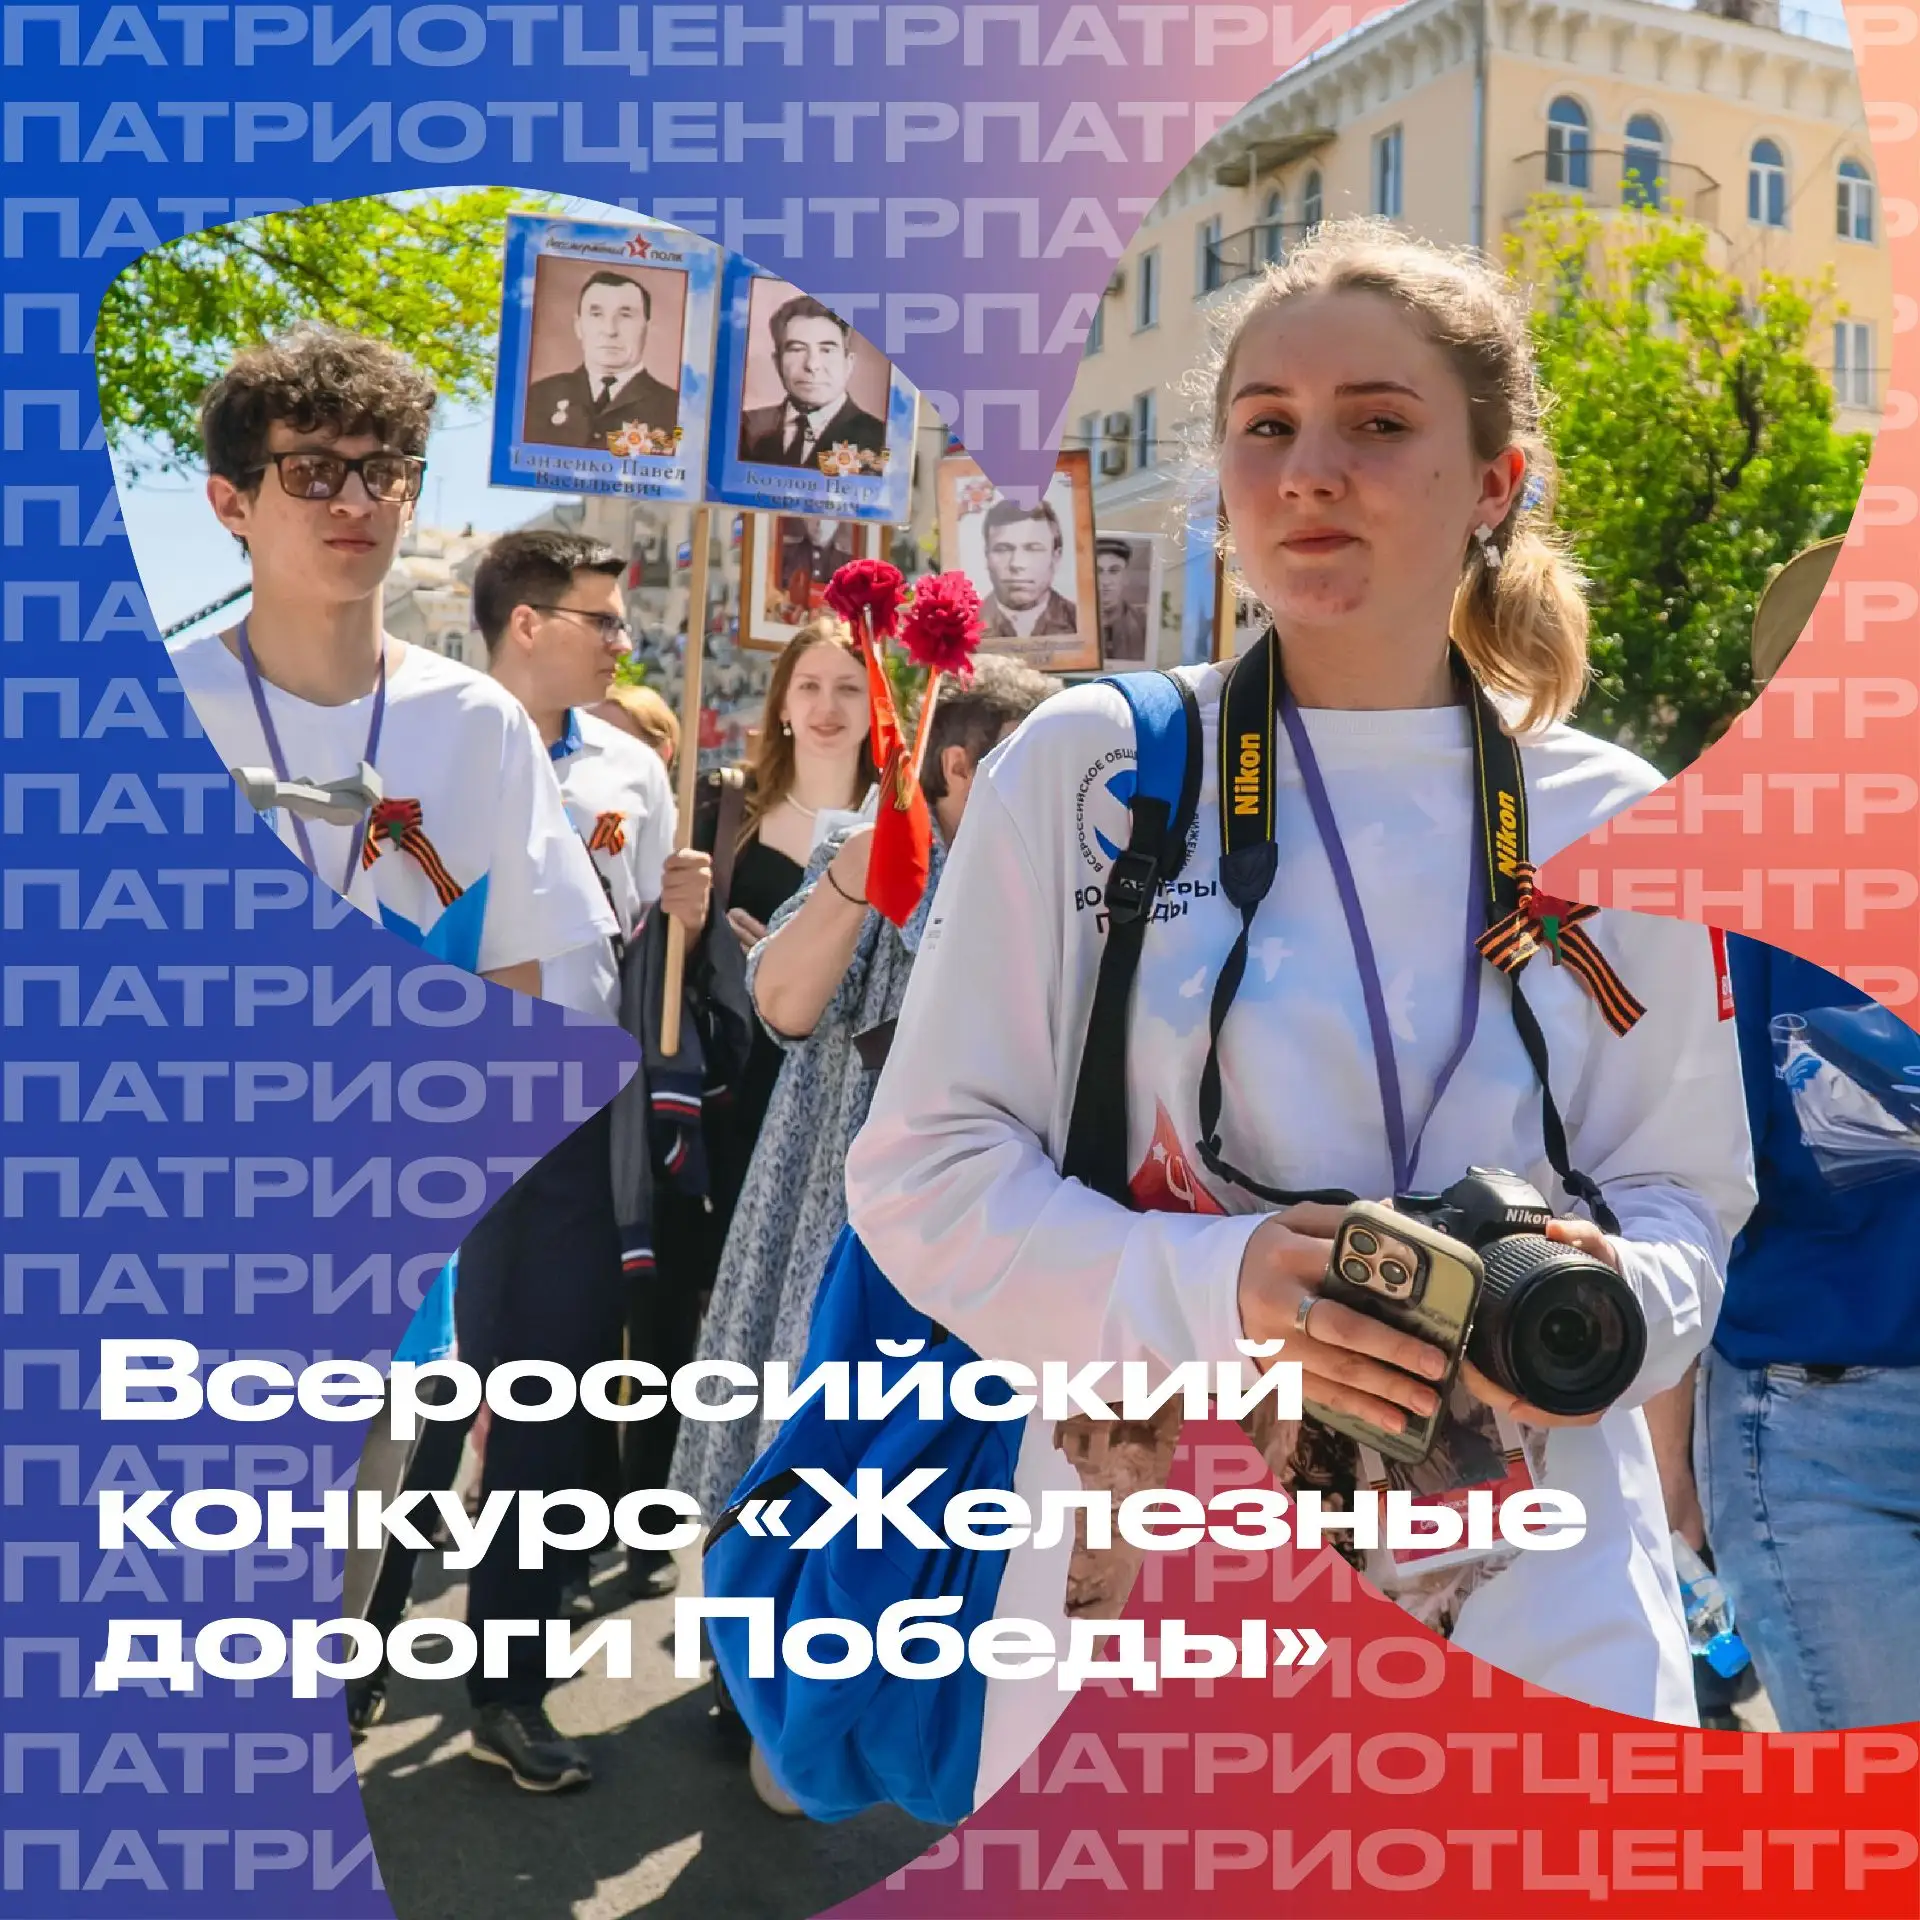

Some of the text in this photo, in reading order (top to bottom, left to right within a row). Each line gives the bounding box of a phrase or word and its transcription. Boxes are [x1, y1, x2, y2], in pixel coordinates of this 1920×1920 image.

[622, 459, 686, 482] Павел
[535, 471, 663, 496] Васильевич
[1104, 747, 1138, 764] ОБЩ
[1233, 734, 1261, 815] Nikon
[1495, 790, 1518, 880] Nikon
